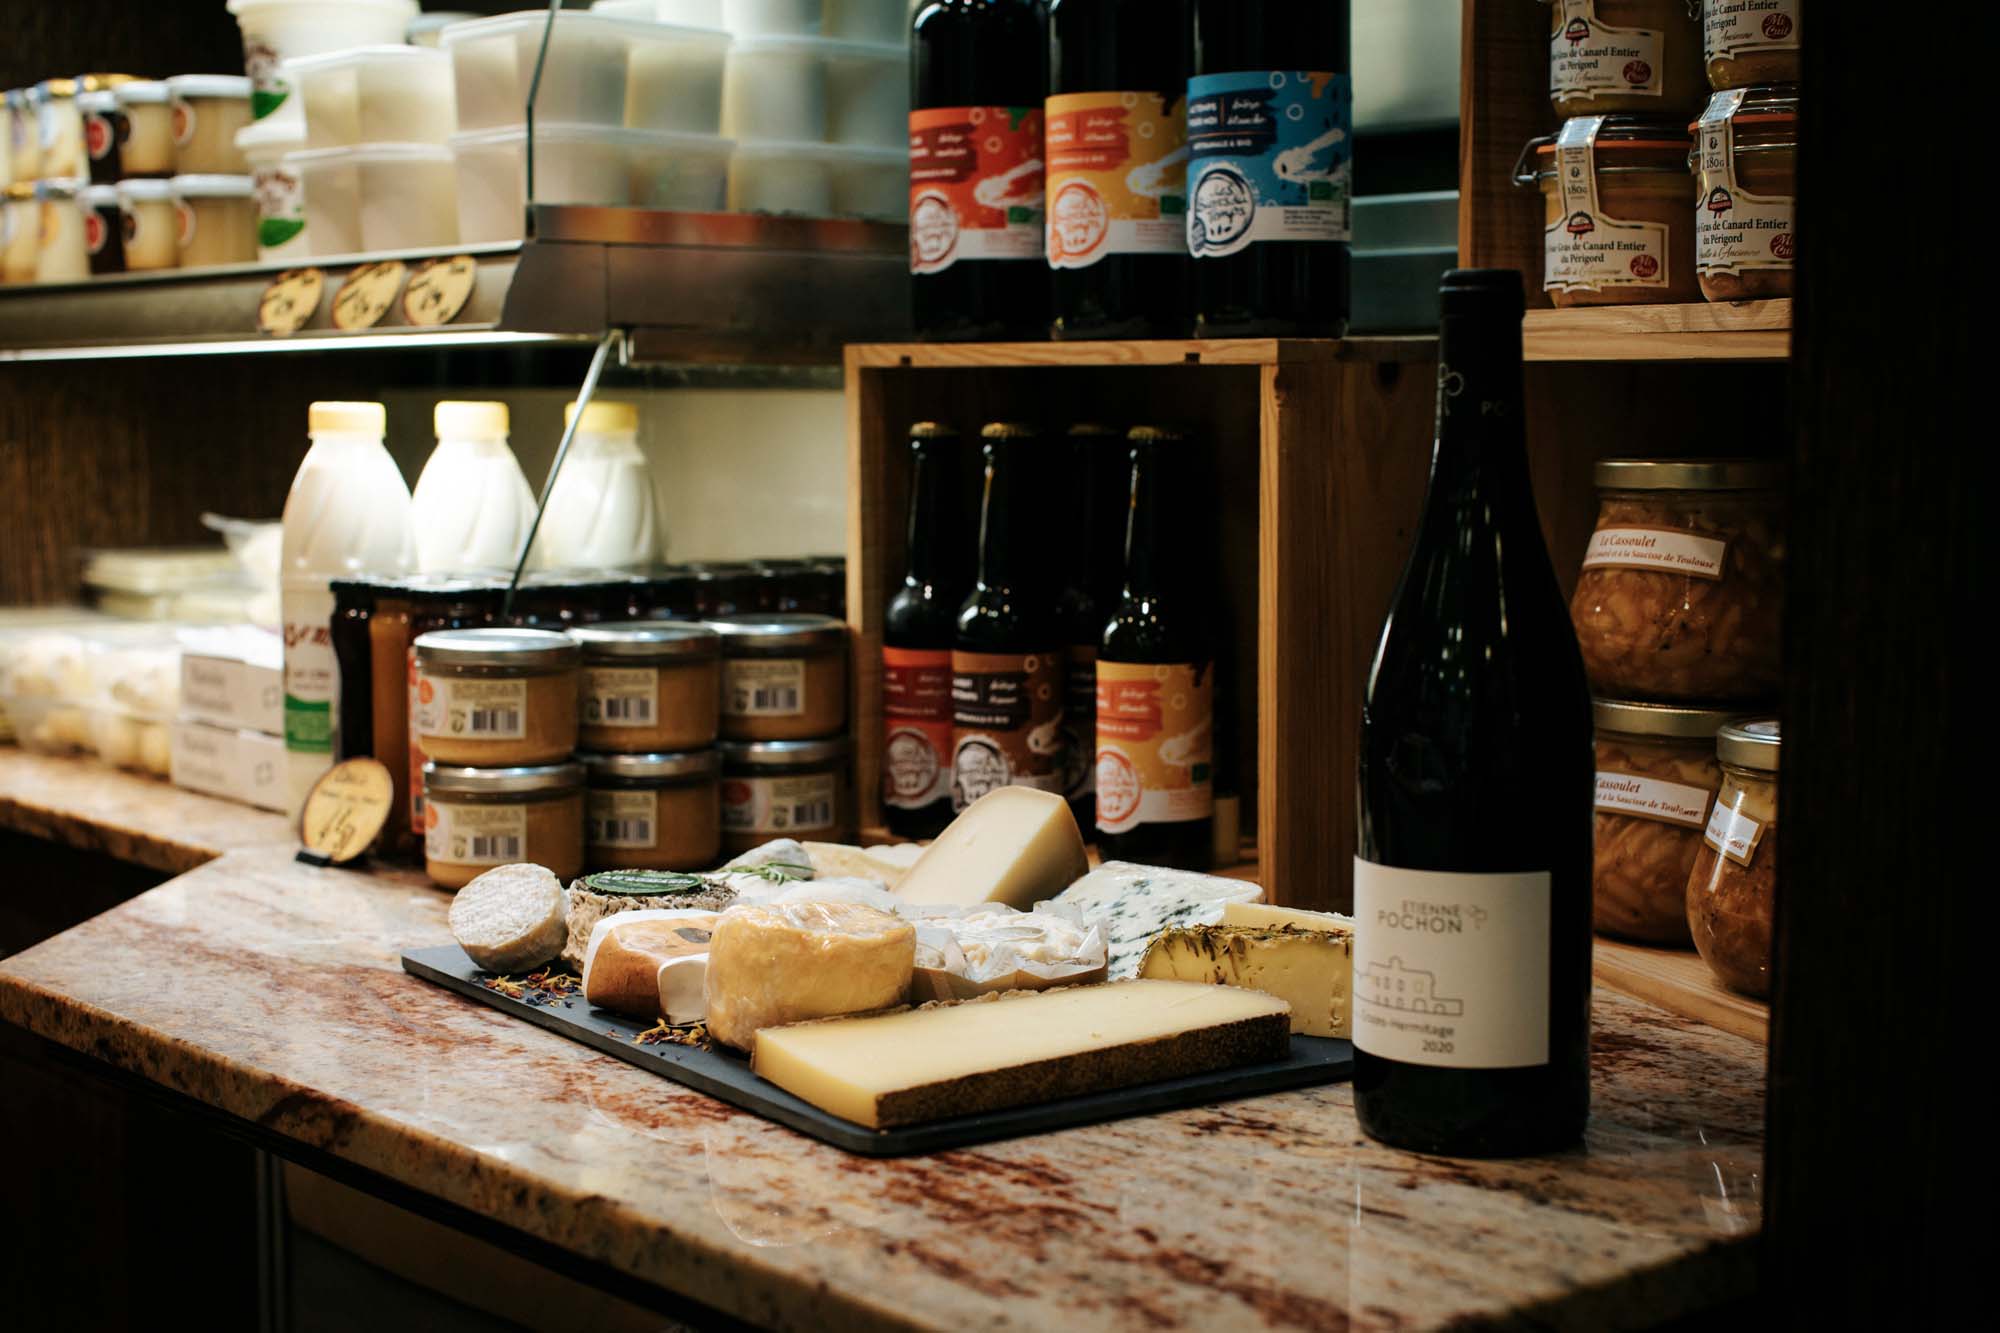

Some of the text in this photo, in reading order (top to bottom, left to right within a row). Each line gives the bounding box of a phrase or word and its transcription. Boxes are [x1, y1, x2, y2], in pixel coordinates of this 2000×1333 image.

[1719, 3, 1746, 15] Canard
[1748, 0, 1779, 11] Entier
[1579, 46, 1609, 58] Canard
[1610, 46, 1641, 58] Entier
[1712, 220, 1721, 231] de
[1722, 218, 1753, 231] Canard
[1756, 218, 1789, 230] Entier
[1572, 241, 1582, 251] de
[1583, 240, 1615, 251] Canard
[1617, 240, 1648, 252] Entier
[1711, 231, 1743, 247] Périgord
[1570, 252, 1605, 265] Périgord
[1610, 534, 1657, 548] Cassoulet
[1632, 550, 1662, 561] Saucisse
[1663, 552, 1675, 562] de
[1676, 553, 1716, 569] Toulouse
[1648, 799, 1659, 809] de
[1402, 900, 1461, 917] ETIENNE
[1421, 1039, 1455, 1053] 2020
